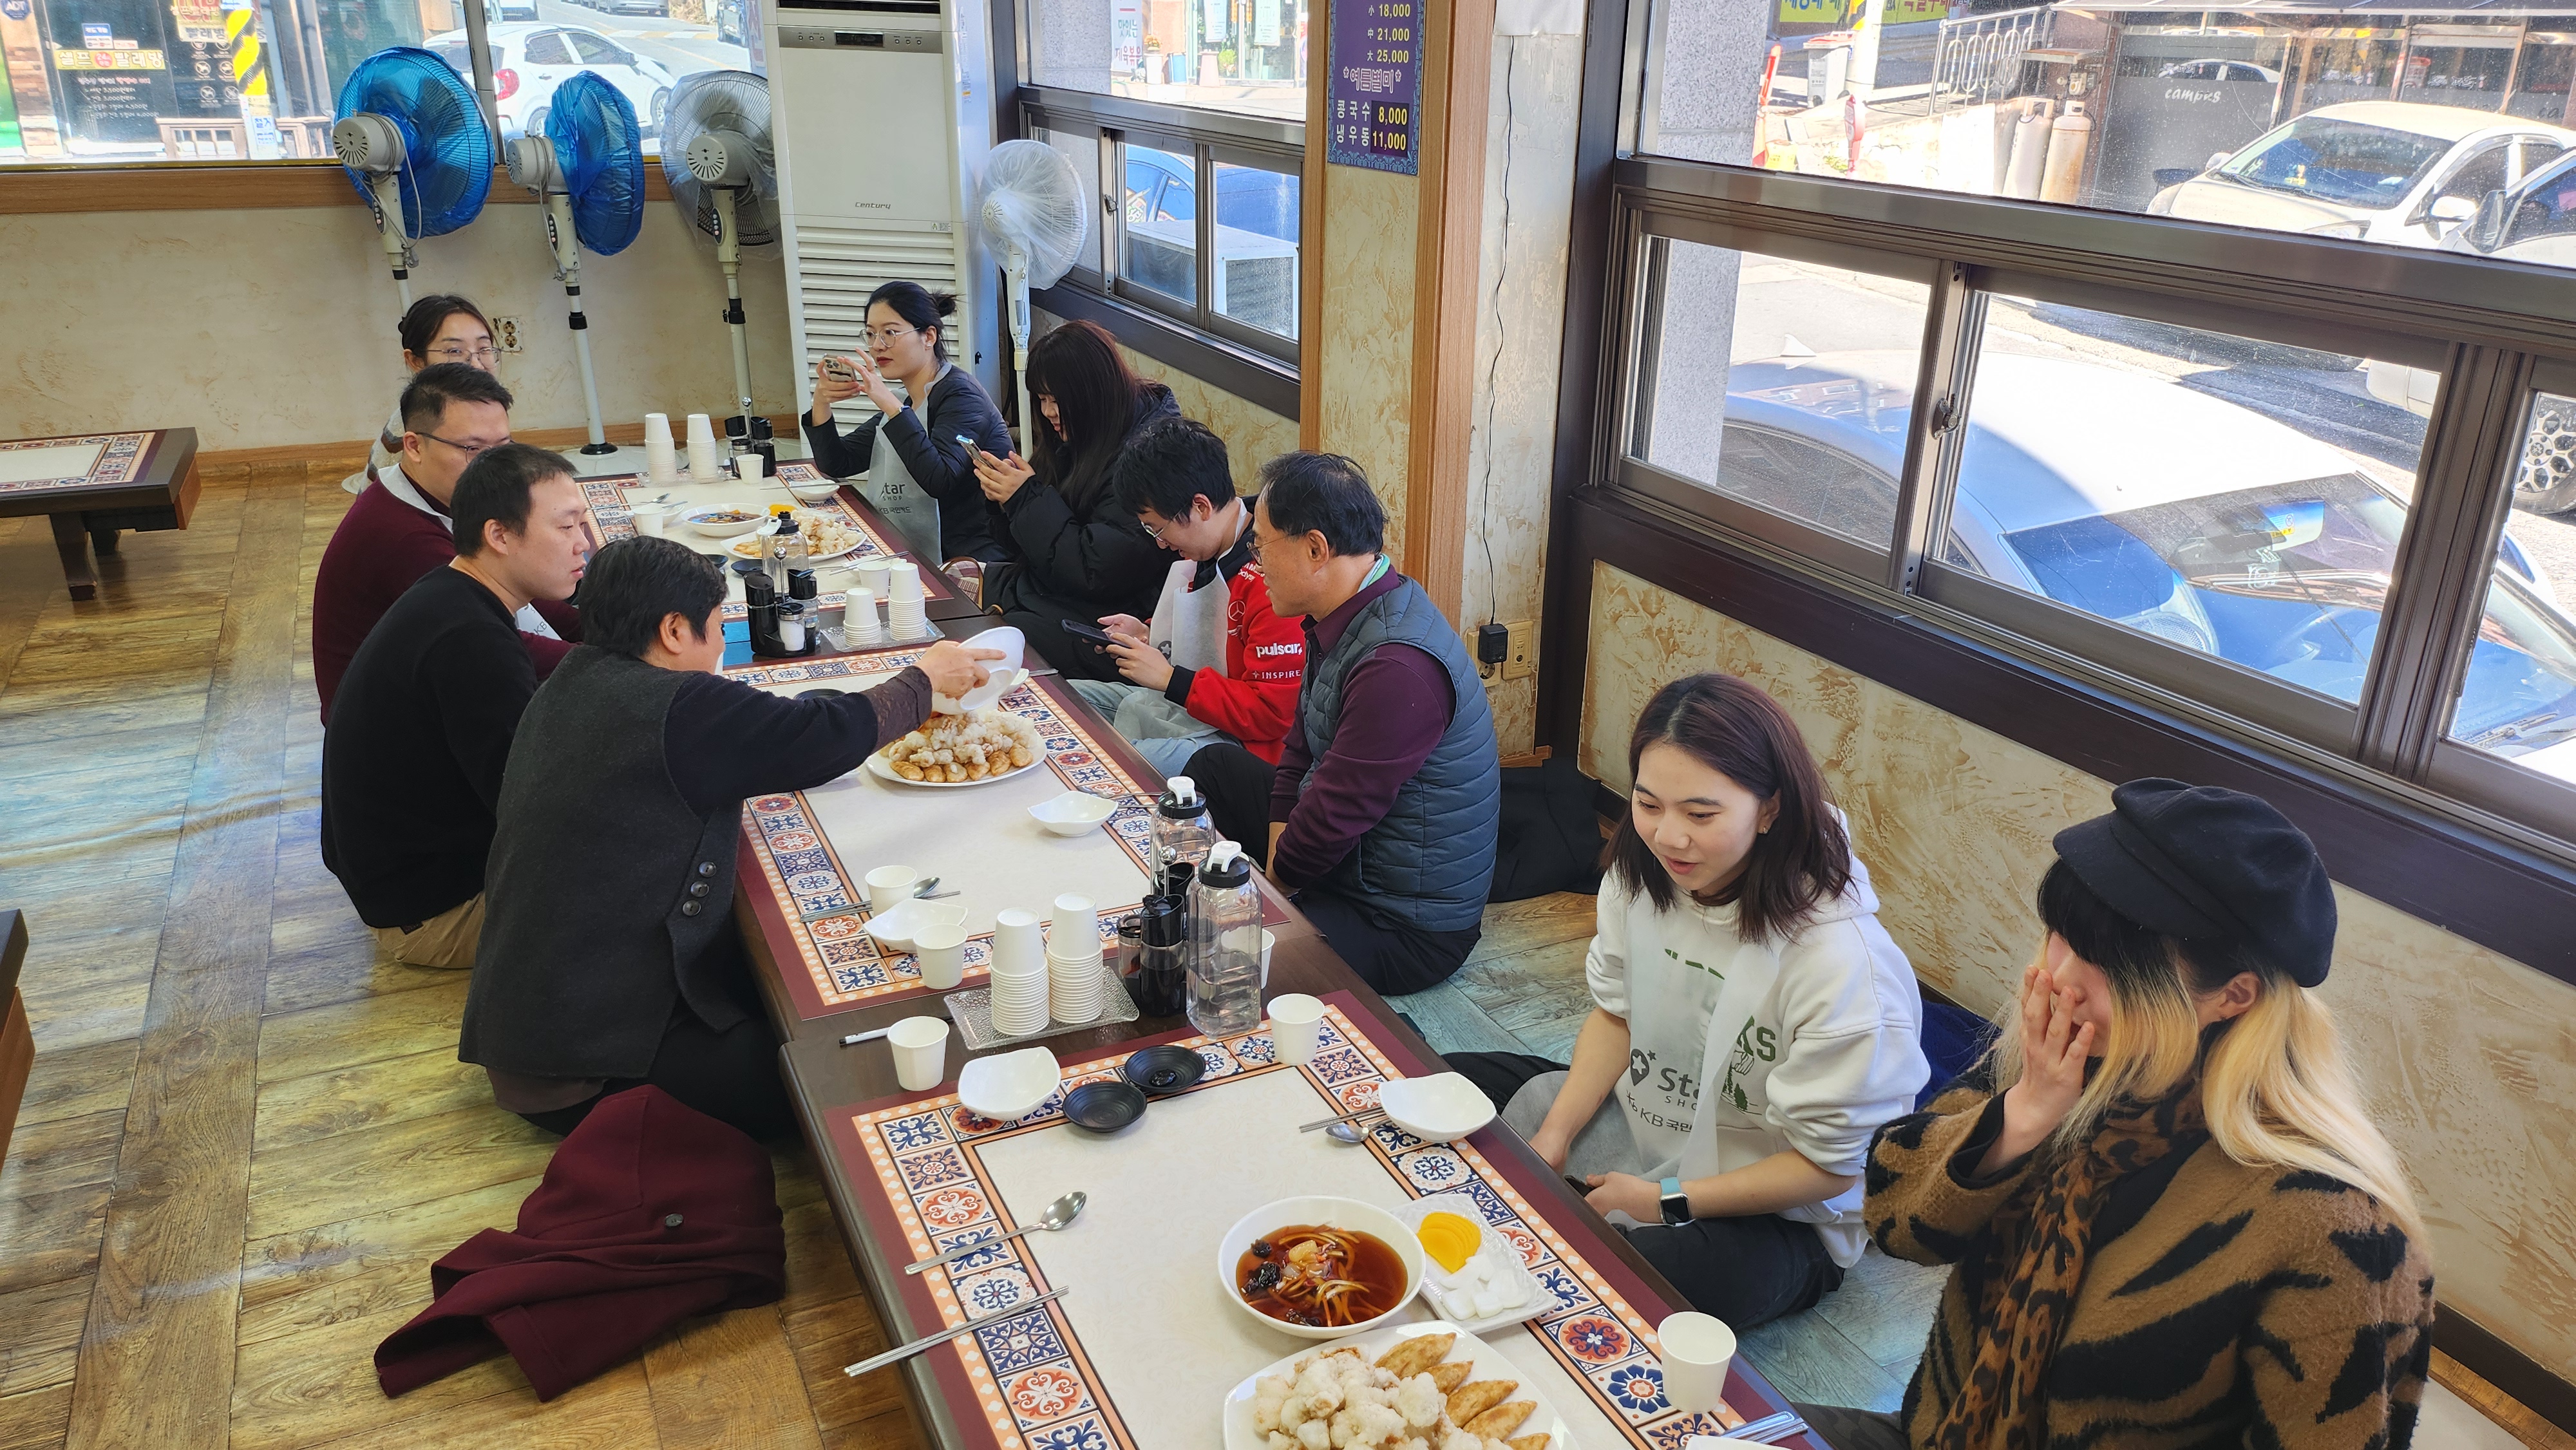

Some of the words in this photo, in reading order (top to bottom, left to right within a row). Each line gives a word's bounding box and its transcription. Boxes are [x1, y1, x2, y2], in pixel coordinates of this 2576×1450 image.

[6, 1, 25, 11] ADT
[1379, 4, 1411, 19] 18,000
[1117, 19, 1138, 38] 맛있는
[1377, 28, 1410, 42] 21,000
[59, 51, 93, 66] 셀프
[113, 51, 164, 69] 빨래방
[1115, 46, 1142, 66] 제육볶음
[1367, 50, 1374, 62] 大
[1377, 49, 1409, 64] 25,000
[1349, 67, 1394, 94] 여름별미
[2164, 88, 2222, 104] campus
[1378, 106, 1408, 126] 8,000
[1372, 130, 1406, 151] 11,000
[855, 202, 891, 210] Century
[879, 482, 905, 496] tar
[1255, 643, 1301, 658] pulsar
[1262, 670, 1301, 679] INSPIRE
[1657, 1067, 1701, 1100] St
[1664, 1095, 1698, 1111] SHO
